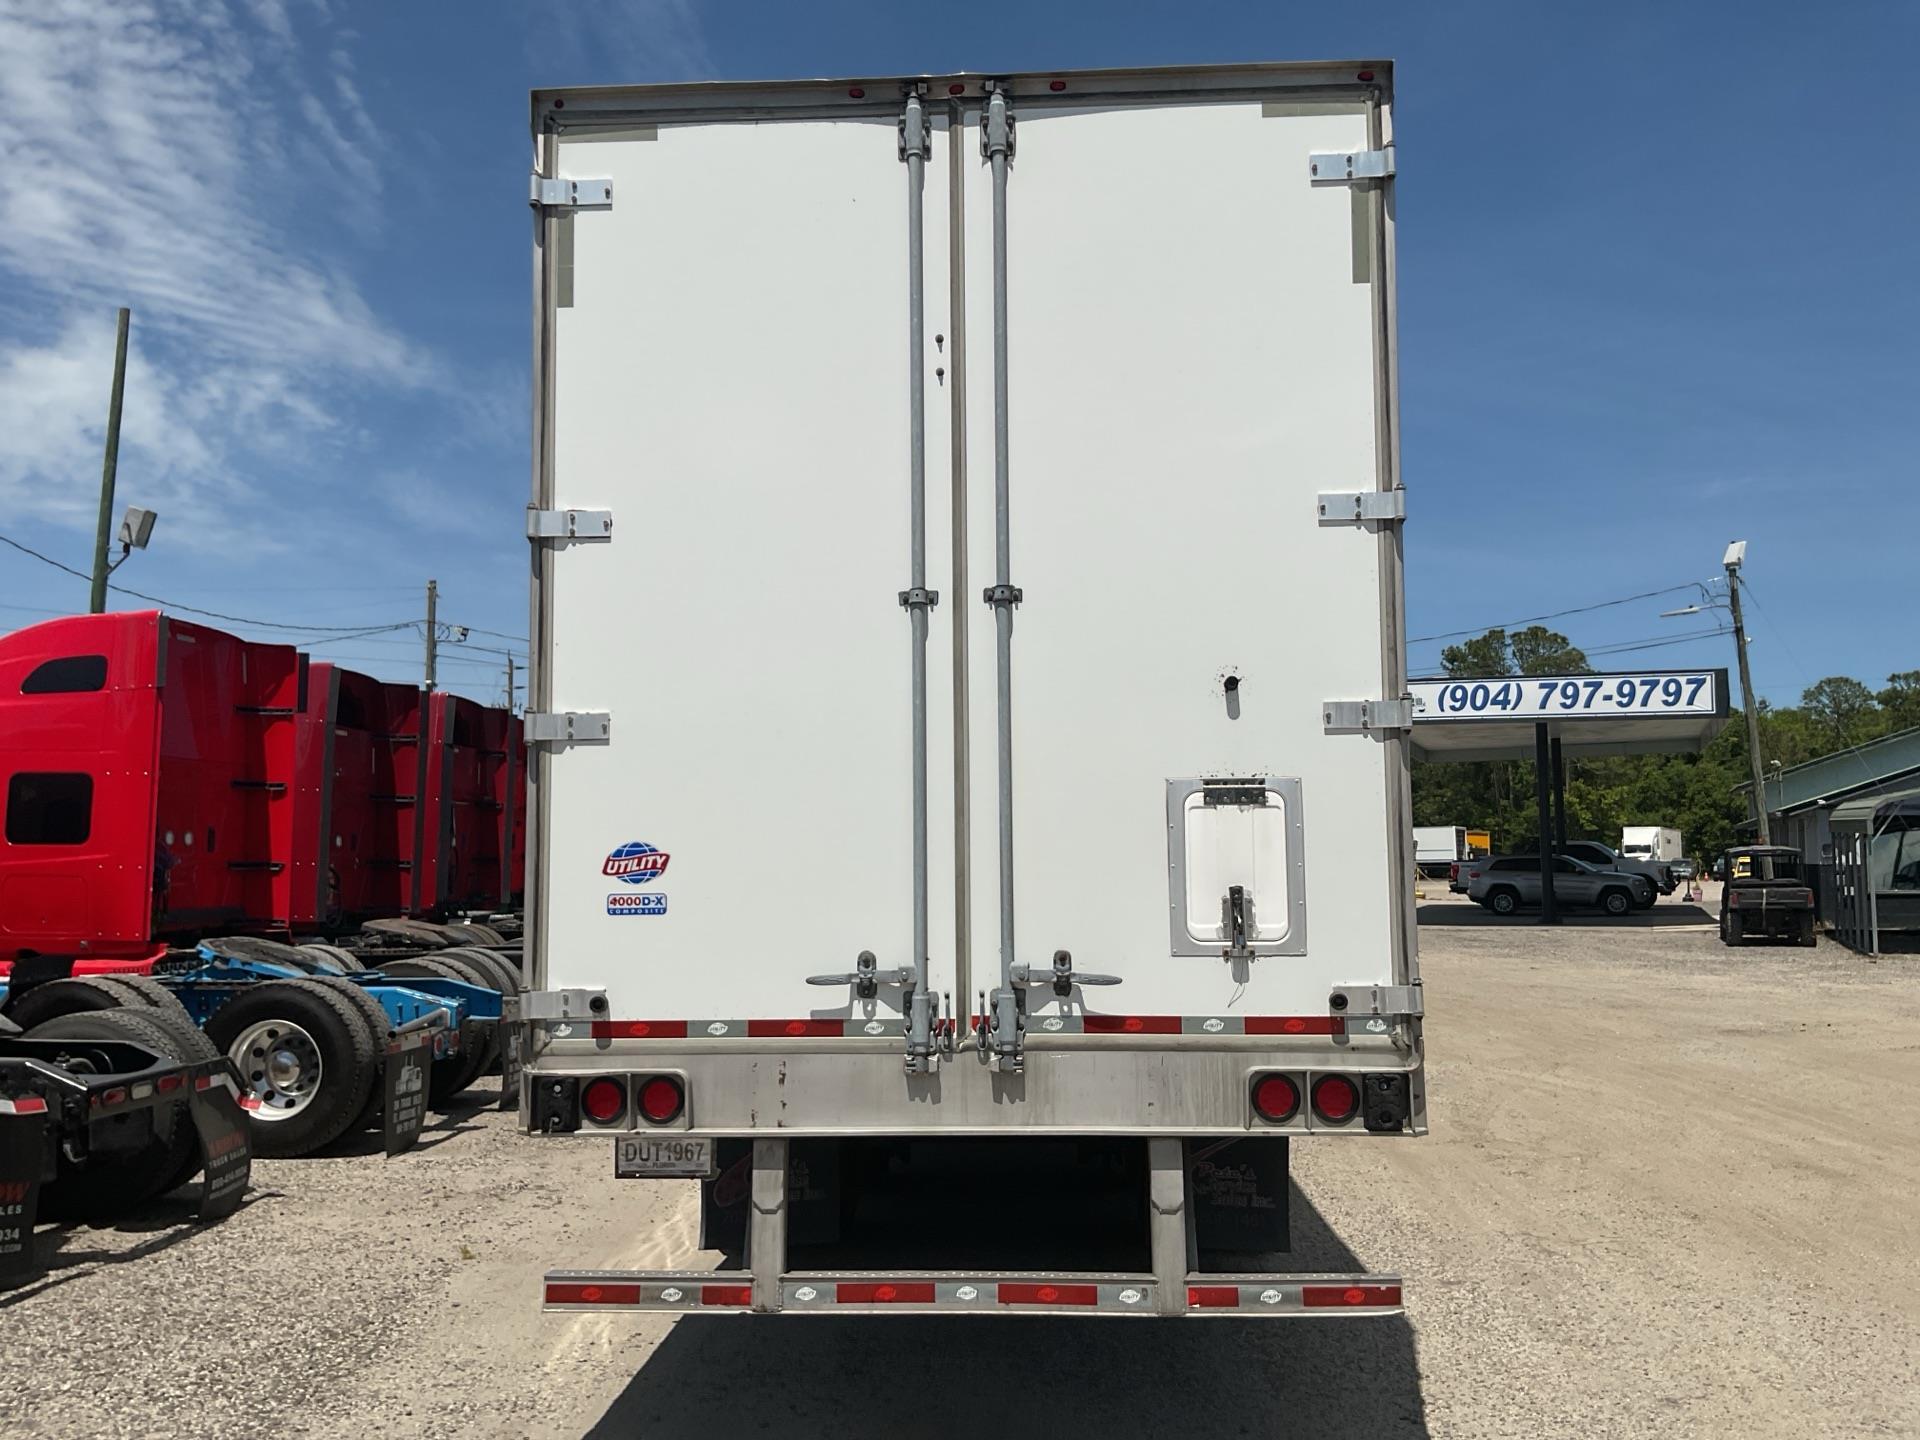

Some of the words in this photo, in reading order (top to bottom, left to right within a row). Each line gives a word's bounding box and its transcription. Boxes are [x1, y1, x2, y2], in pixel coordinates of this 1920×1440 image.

[1438, 683, 1522, 712] (904)
[1538, 677, 1707, 710] 797-9797
[606, 855, 667, 874] UTILITY
[625, 1142, 704, 1162] DUT1967
